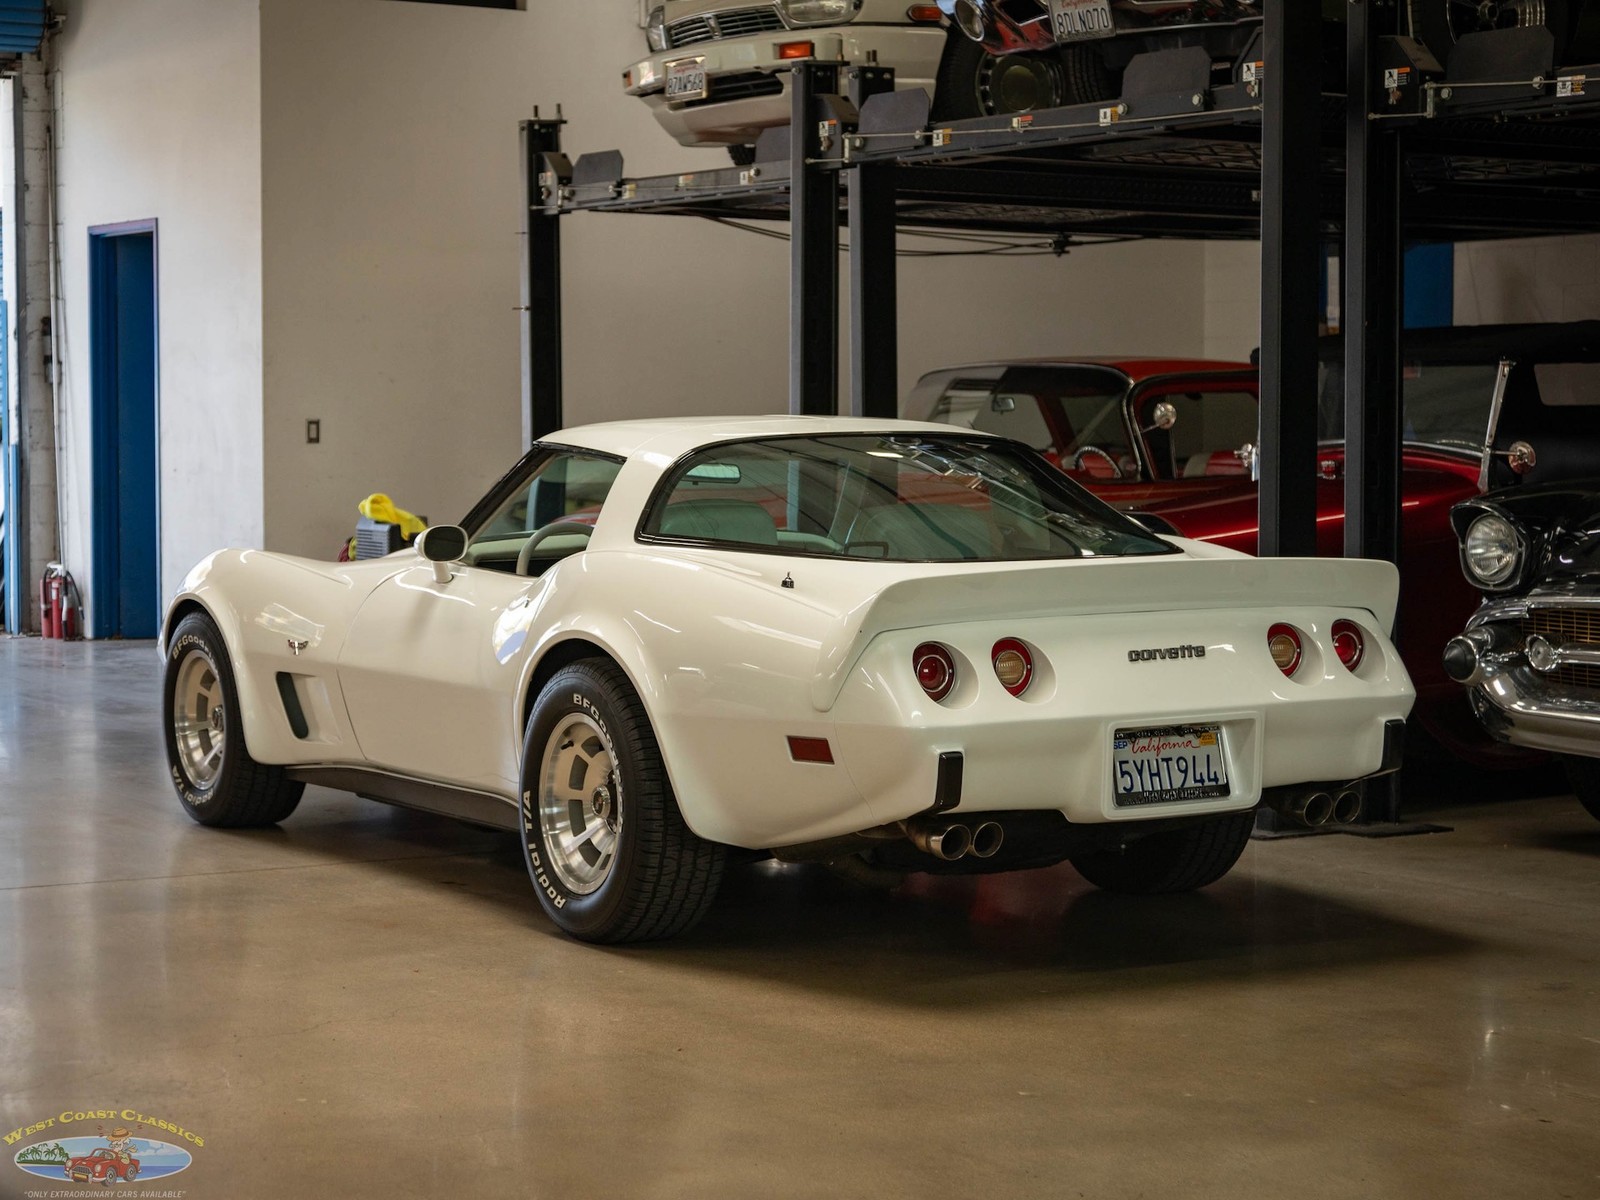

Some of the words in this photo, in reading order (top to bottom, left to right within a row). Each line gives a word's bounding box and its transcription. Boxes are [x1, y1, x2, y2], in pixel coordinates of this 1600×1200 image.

[1057, 8, 1109, 34] 8DLN070
[1127, 644, 1206, 662] corvette
[1113, 740, 1128, 750] SEP
[1131, 737, 1200, 757] California
[1118, 754, 1219, 793] 5YHT944
[523, 790, 533, 834] T/A
[528, 843, 567, 909] Radial
